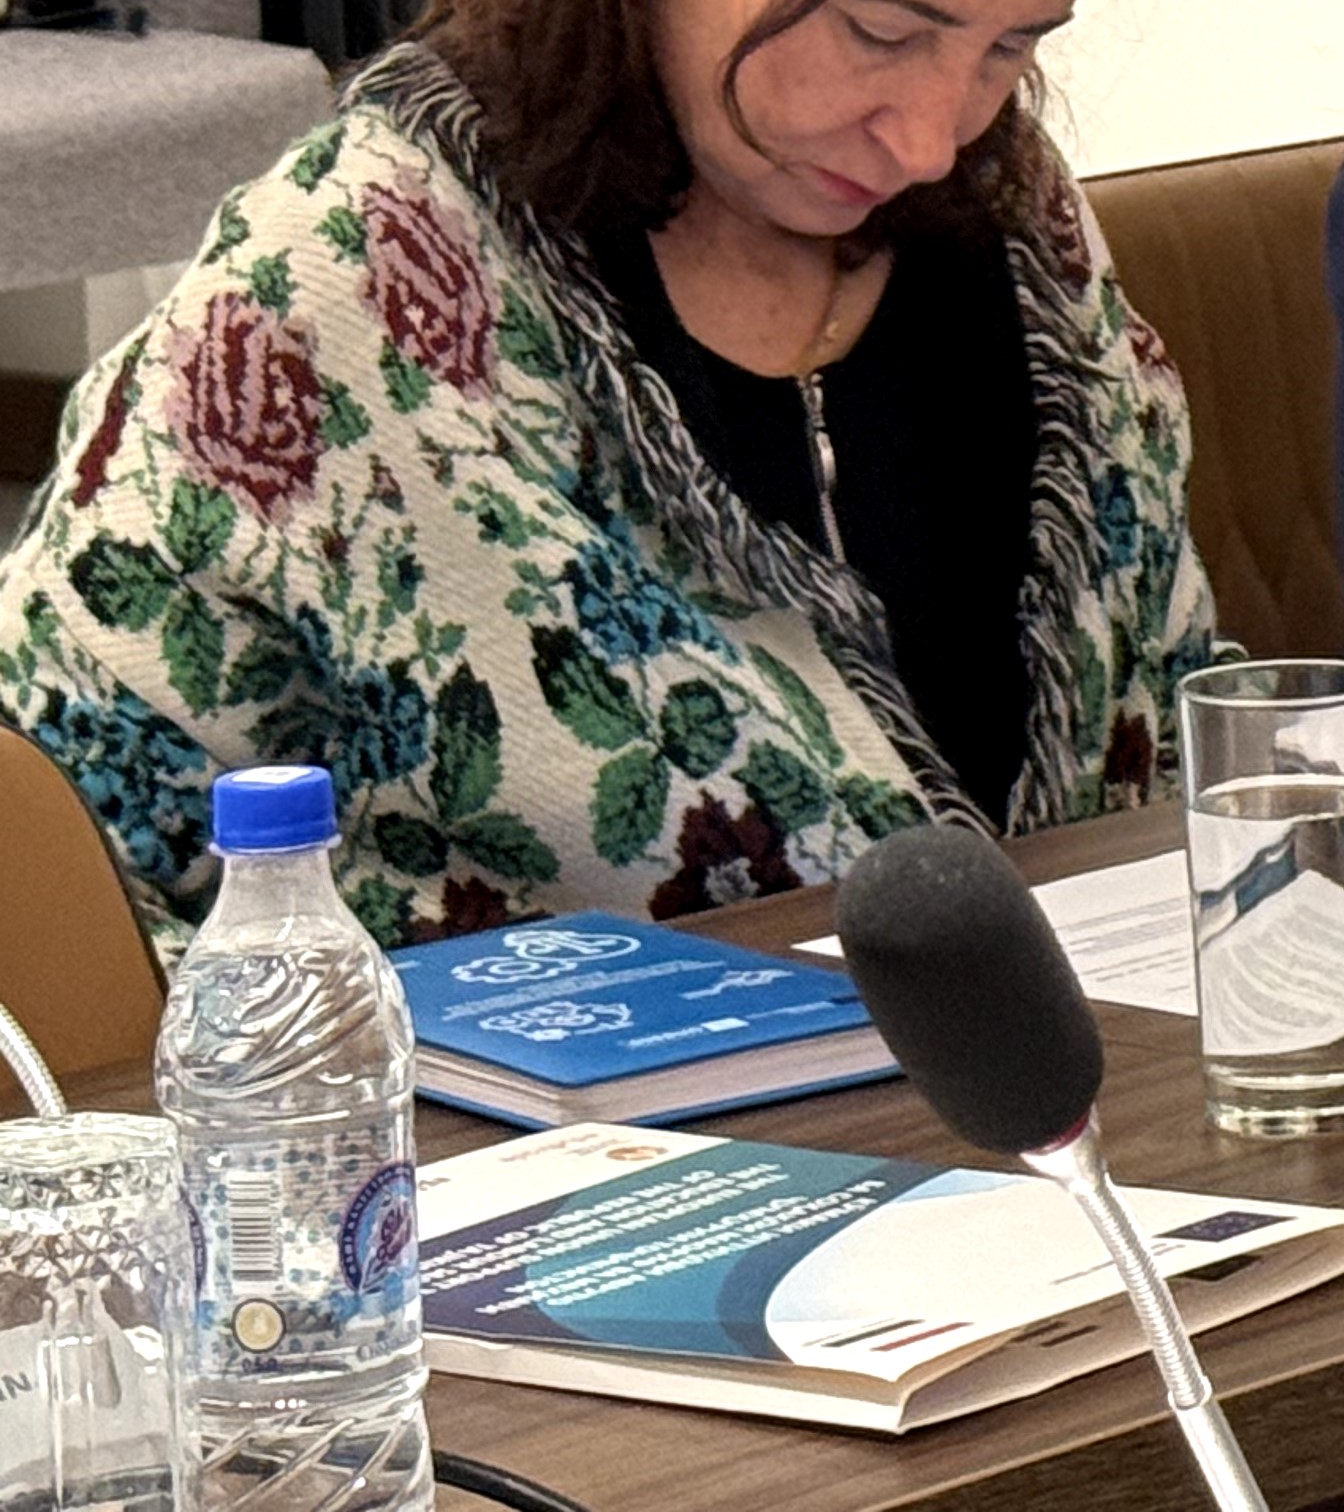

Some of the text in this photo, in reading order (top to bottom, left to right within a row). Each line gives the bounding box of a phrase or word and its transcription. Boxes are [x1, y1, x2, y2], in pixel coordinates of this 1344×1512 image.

[683, 1170, 715, 1183] OF
[726, 1163, 780, 1179] THE
[630, 1183, 686, 1198] THE
[735, 1174, 789, 1190] THE
[601, 1178, 734, 1221] EDUCATION
[617, 1189, 743, 1230] EUROPEAN
[523, 1197, 639, 1233] REPUBLIC
[494, 1231, 529, 1243] OF
[550, 1219, 605, 1239] AND
[536, 1229, 624, 1255] UNION
[431, 1255, 542, 1290] SUPPORT
